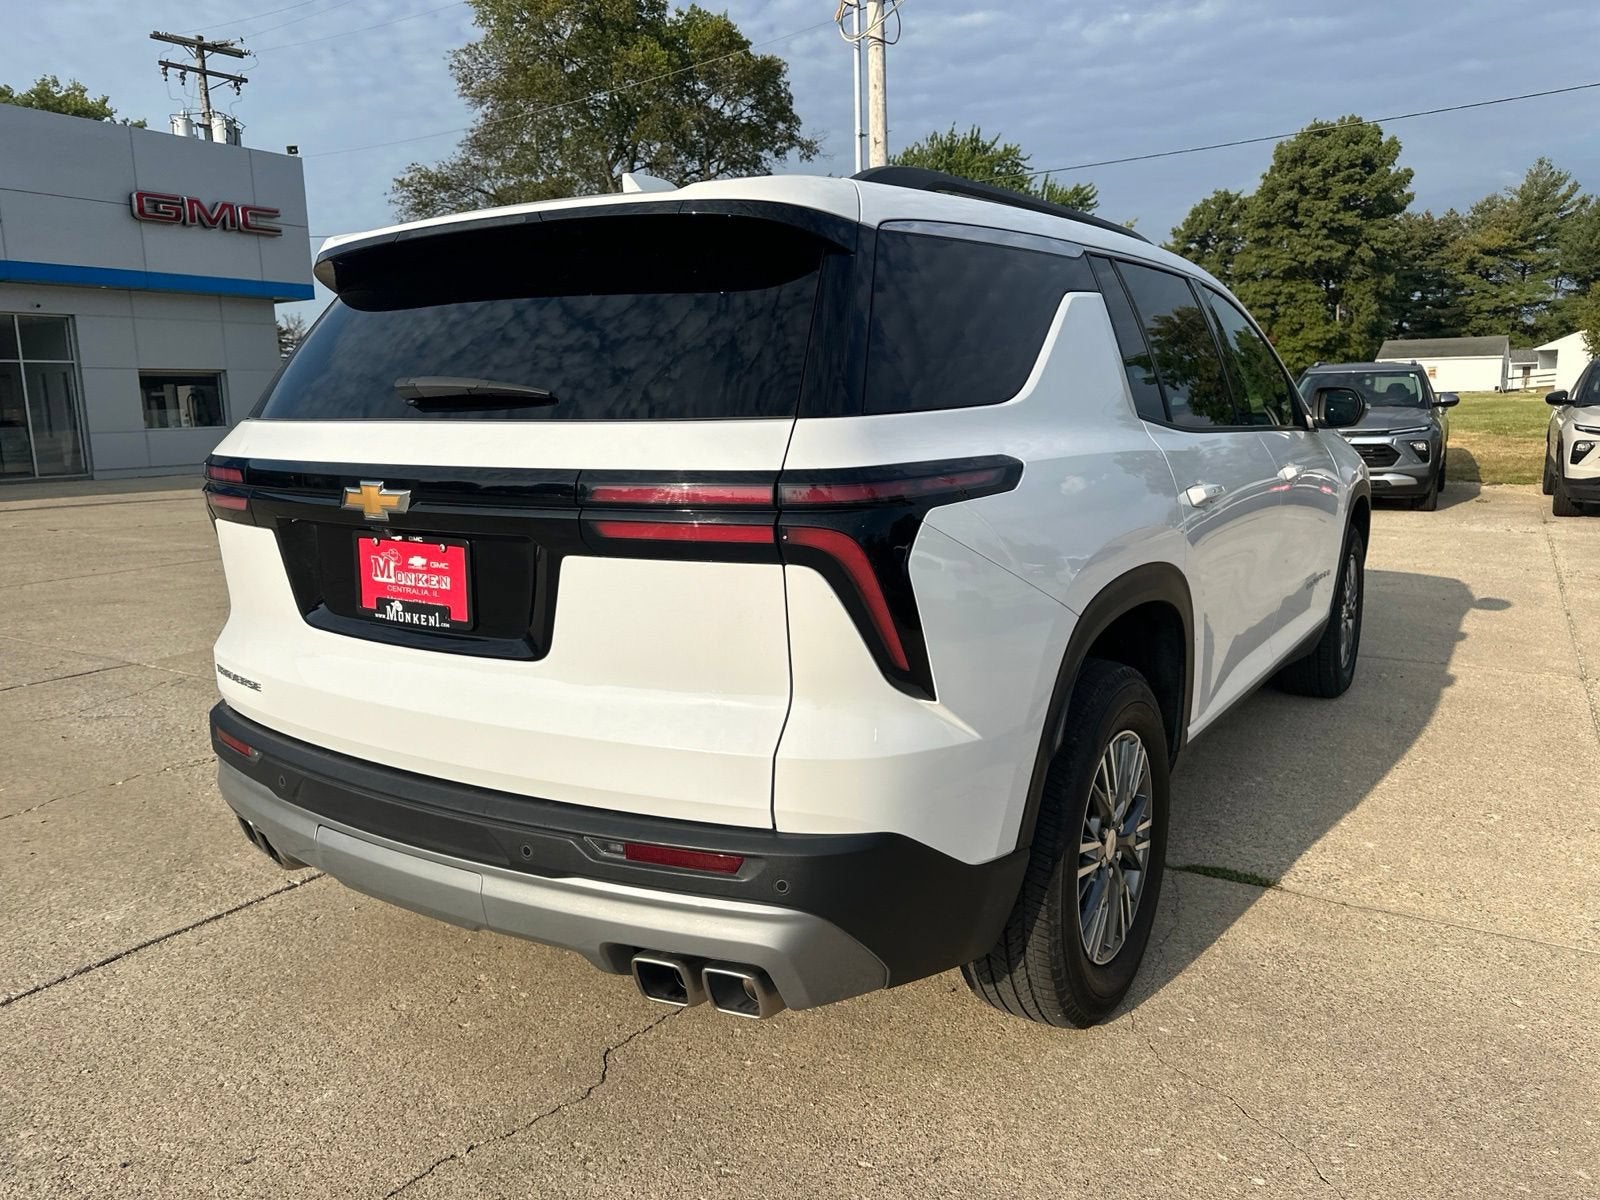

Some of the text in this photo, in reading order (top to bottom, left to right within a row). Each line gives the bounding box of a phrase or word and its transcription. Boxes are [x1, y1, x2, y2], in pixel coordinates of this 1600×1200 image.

[129, 190, 283, 237] GMC
[370, 555, 451, 590] MONKEN
[430, 562, 449, 570] GMC
